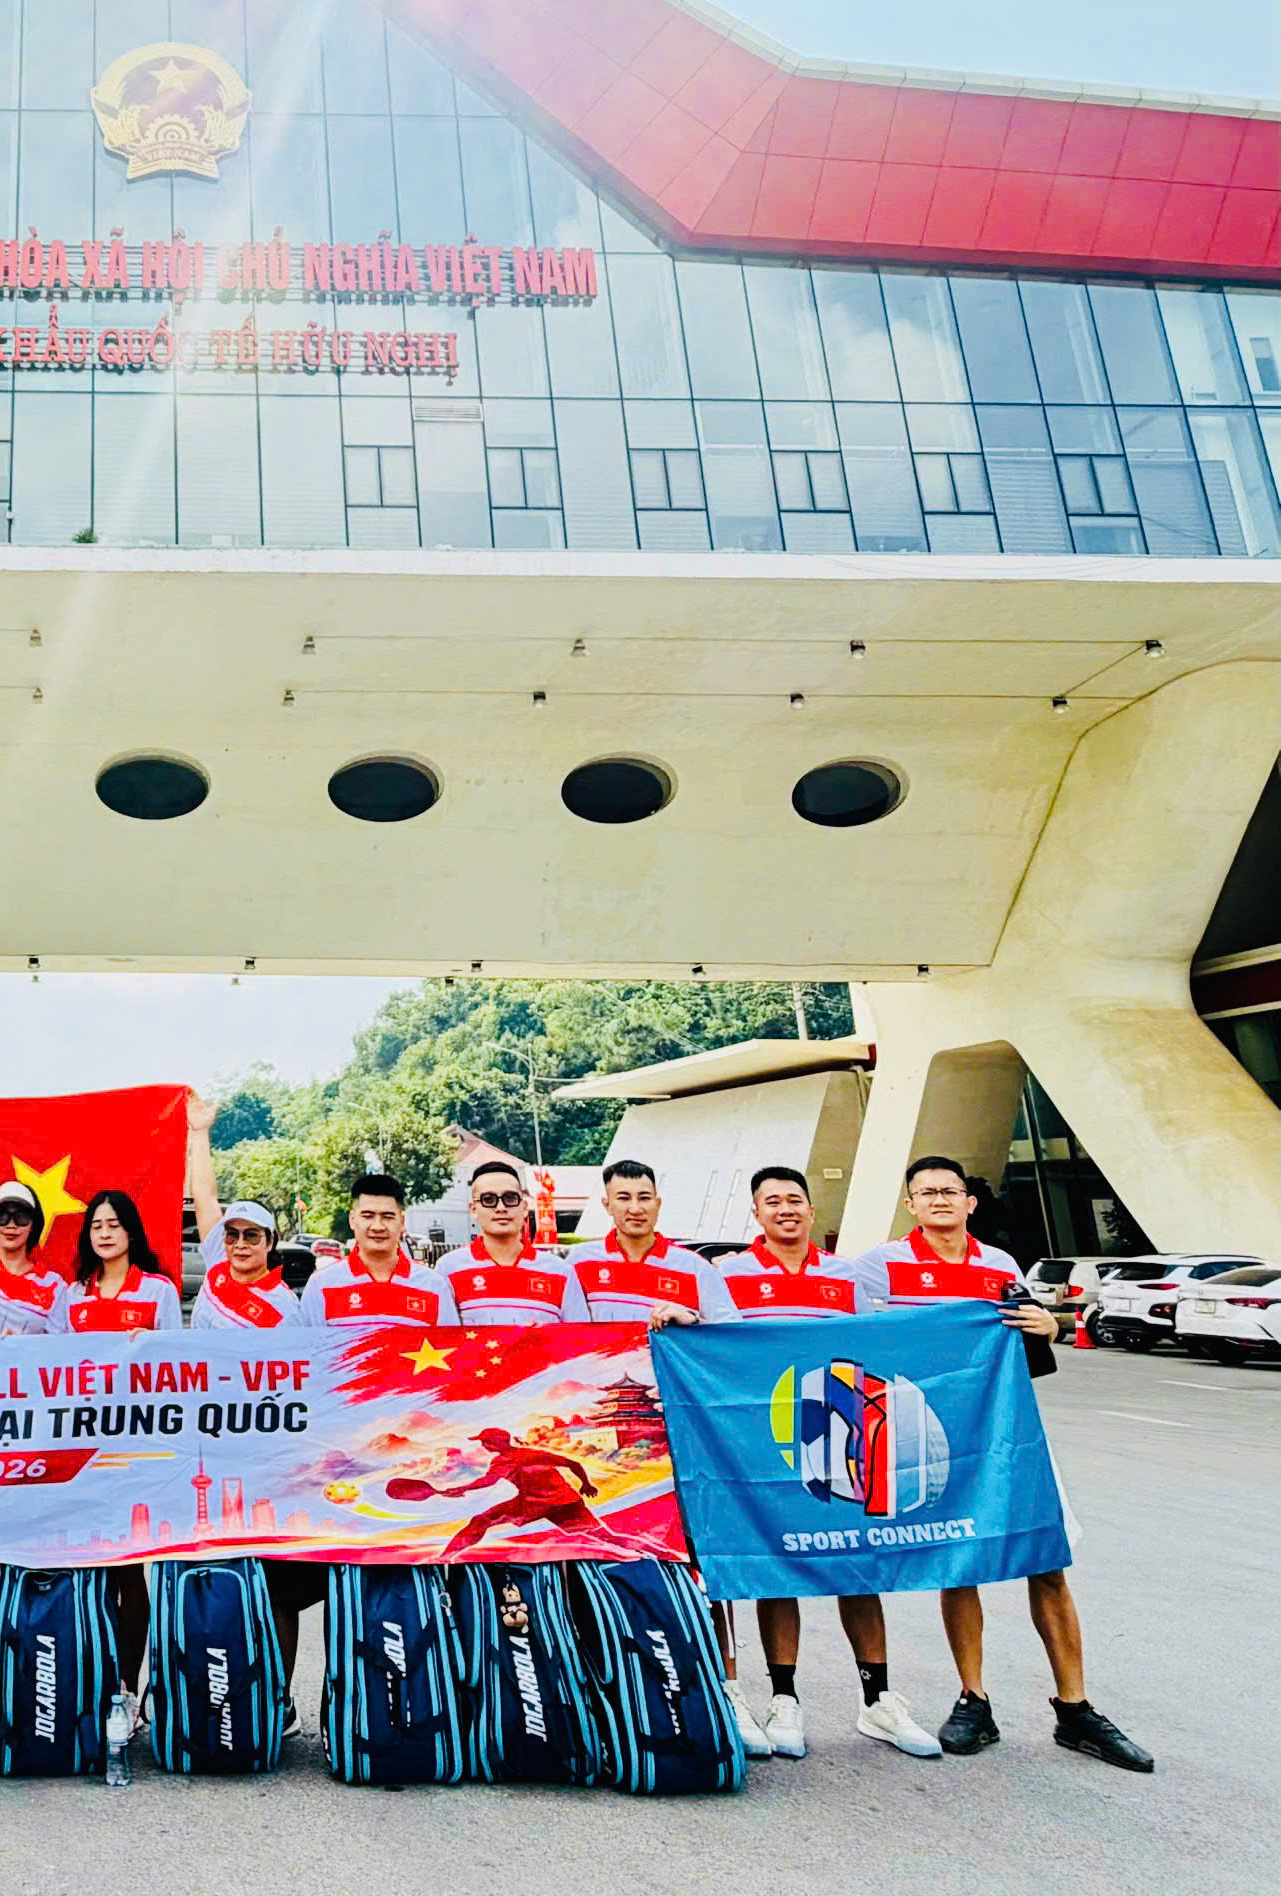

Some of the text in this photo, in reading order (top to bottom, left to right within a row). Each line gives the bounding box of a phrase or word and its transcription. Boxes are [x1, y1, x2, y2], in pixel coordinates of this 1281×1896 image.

[80, 227, 131, 288] XÃ
[142, 228, 204, 304] HỘI
[218, 226, 290, 289] CHỦ
[304, 230, 417, 292] NGHĨA
[425, 233, 503, 307] VIỆT
[512, 246, 598, 297] NAM
[98, 312, 198, 365] QUỐC
[210, 312, 259, 364] TẾ
[271, 321, 352, 367] HỮU
[364, 331, 460, 376] NGHỊ
[39, 1359, 119, 1401] VIỆT
[129, 1361, 209, 1394] NAM
[240, 1360, 311, 1392] VPF
[47, 1404, 183, 1438] TRUNG
[197, 1393, 308, 1438] QUỐC
[782, 1517, 976, 1552] SPORT CONNECT
[35, 1635, 56, 1743] JOGARBOLA
[509, 1635, 547, 1743] JOGARBOLA
